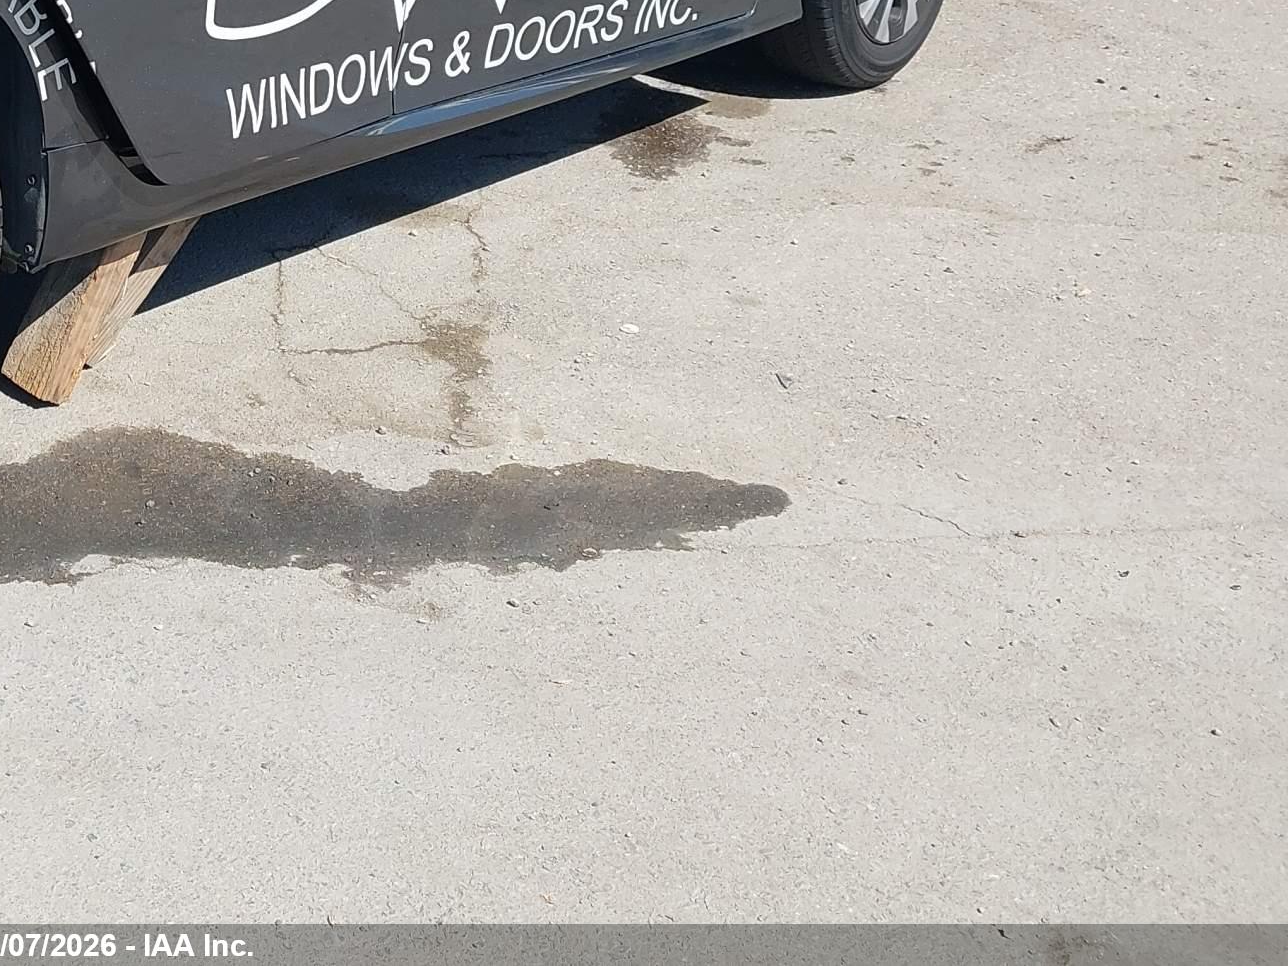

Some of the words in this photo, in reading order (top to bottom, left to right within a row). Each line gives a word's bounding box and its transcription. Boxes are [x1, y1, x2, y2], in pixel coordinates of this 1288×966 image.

[225, 39, 434, 139] WINDOWS
[444, 30, 471, 78] &
[484, 6, 625, 69] DOORS
